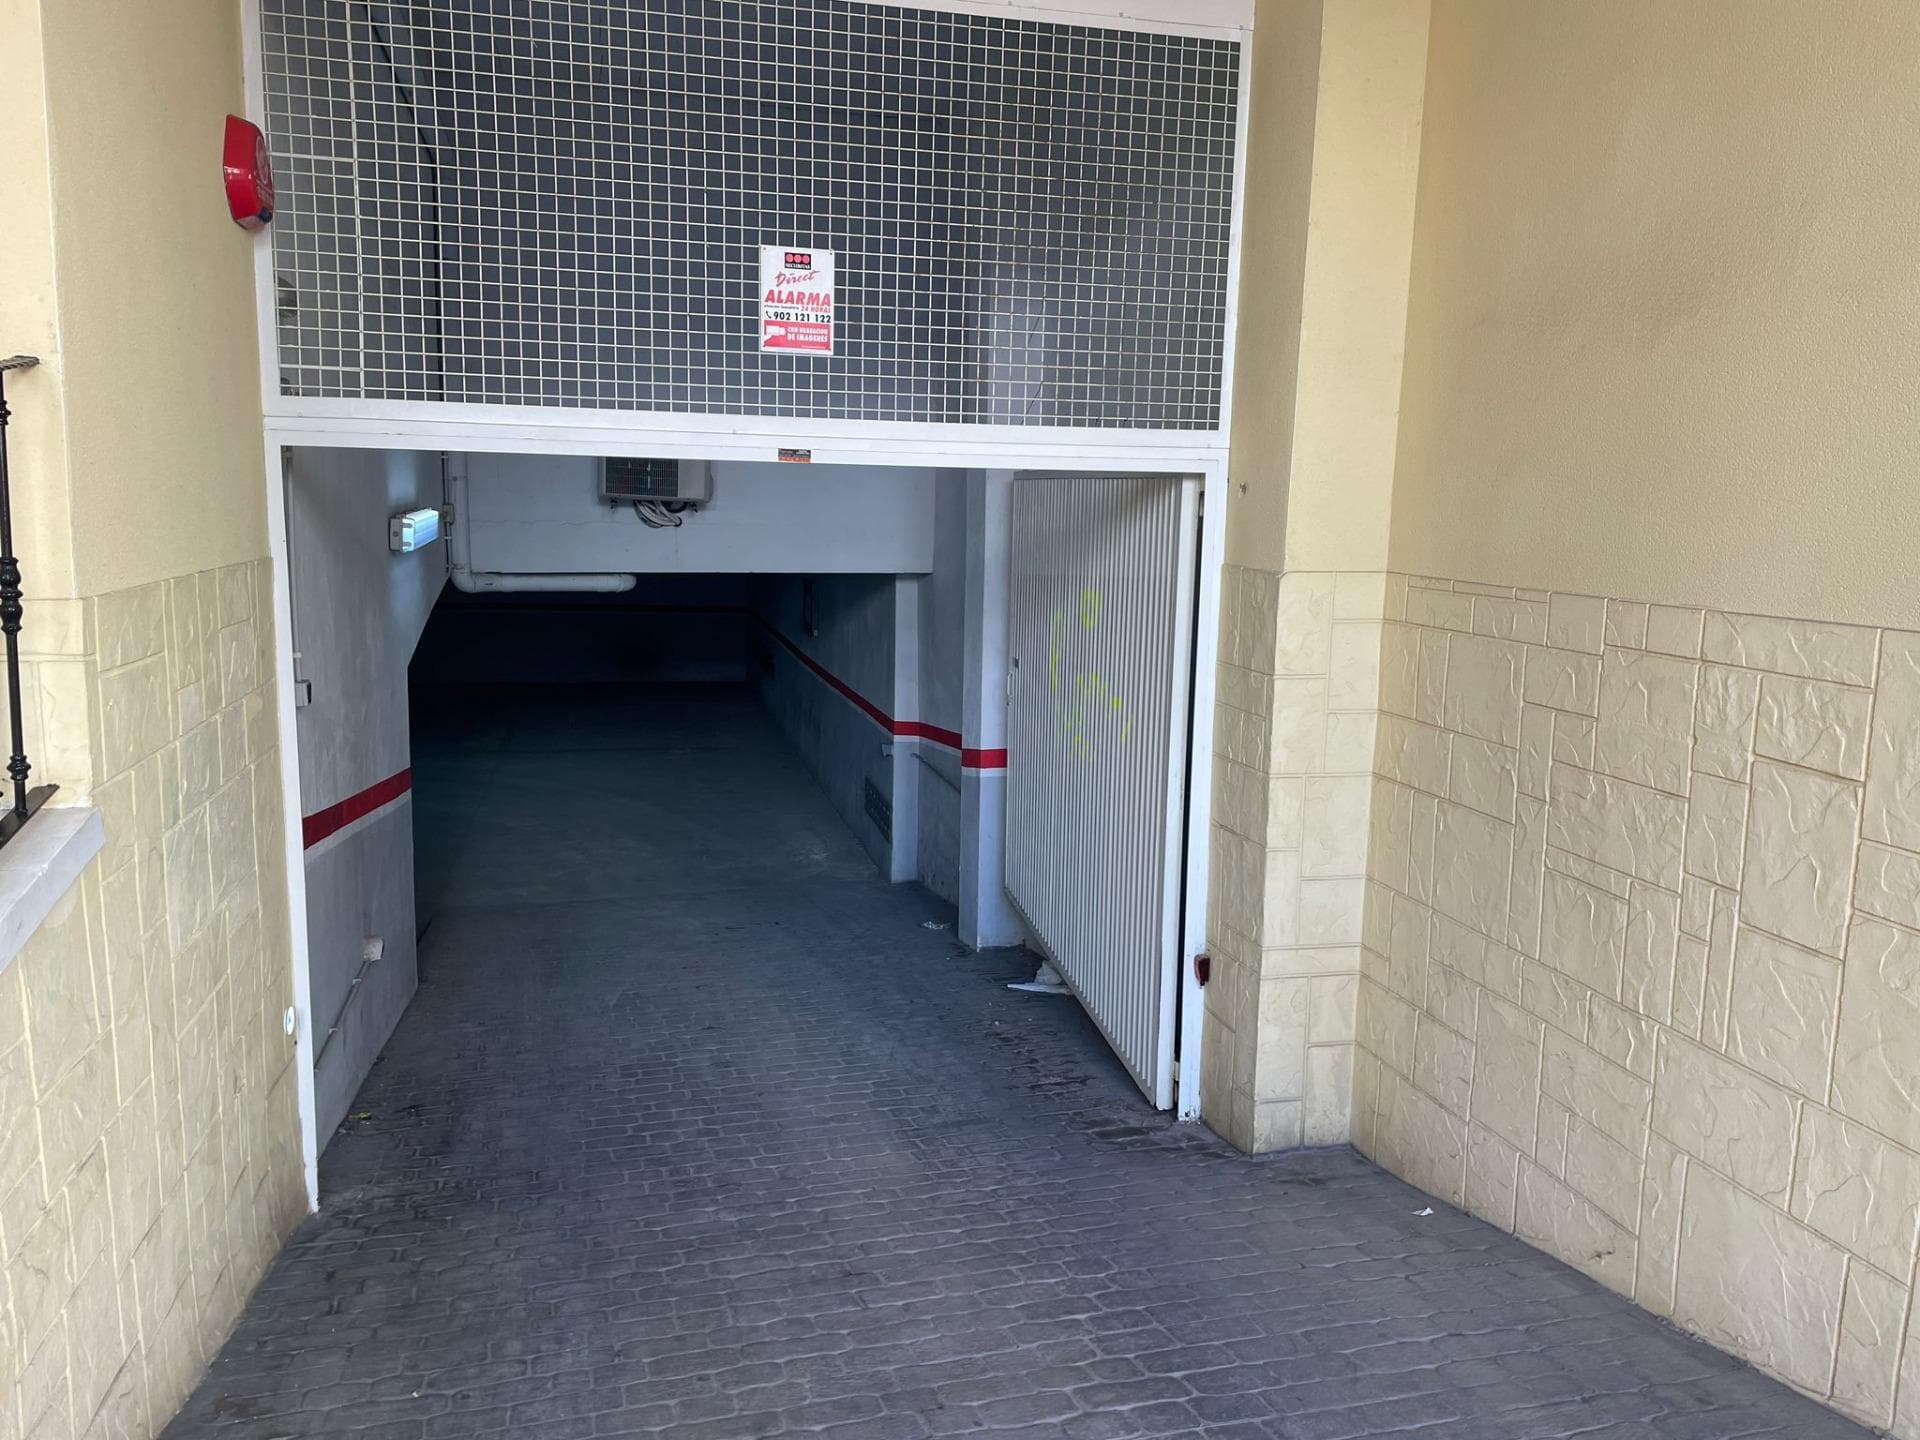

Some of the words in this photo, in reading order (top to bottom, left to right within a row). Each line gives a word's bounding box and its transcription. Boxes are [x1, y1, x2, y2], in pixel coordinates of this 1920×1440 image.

[775, 269, 821, 287] Direct
[765, 289, 831, 306] ALARMA
[773, 311, 791, 321] 902
[795, 313, 810, 322] 121
[815, 314, 832, 323] 122
[787, 333, 795, 341] DE
